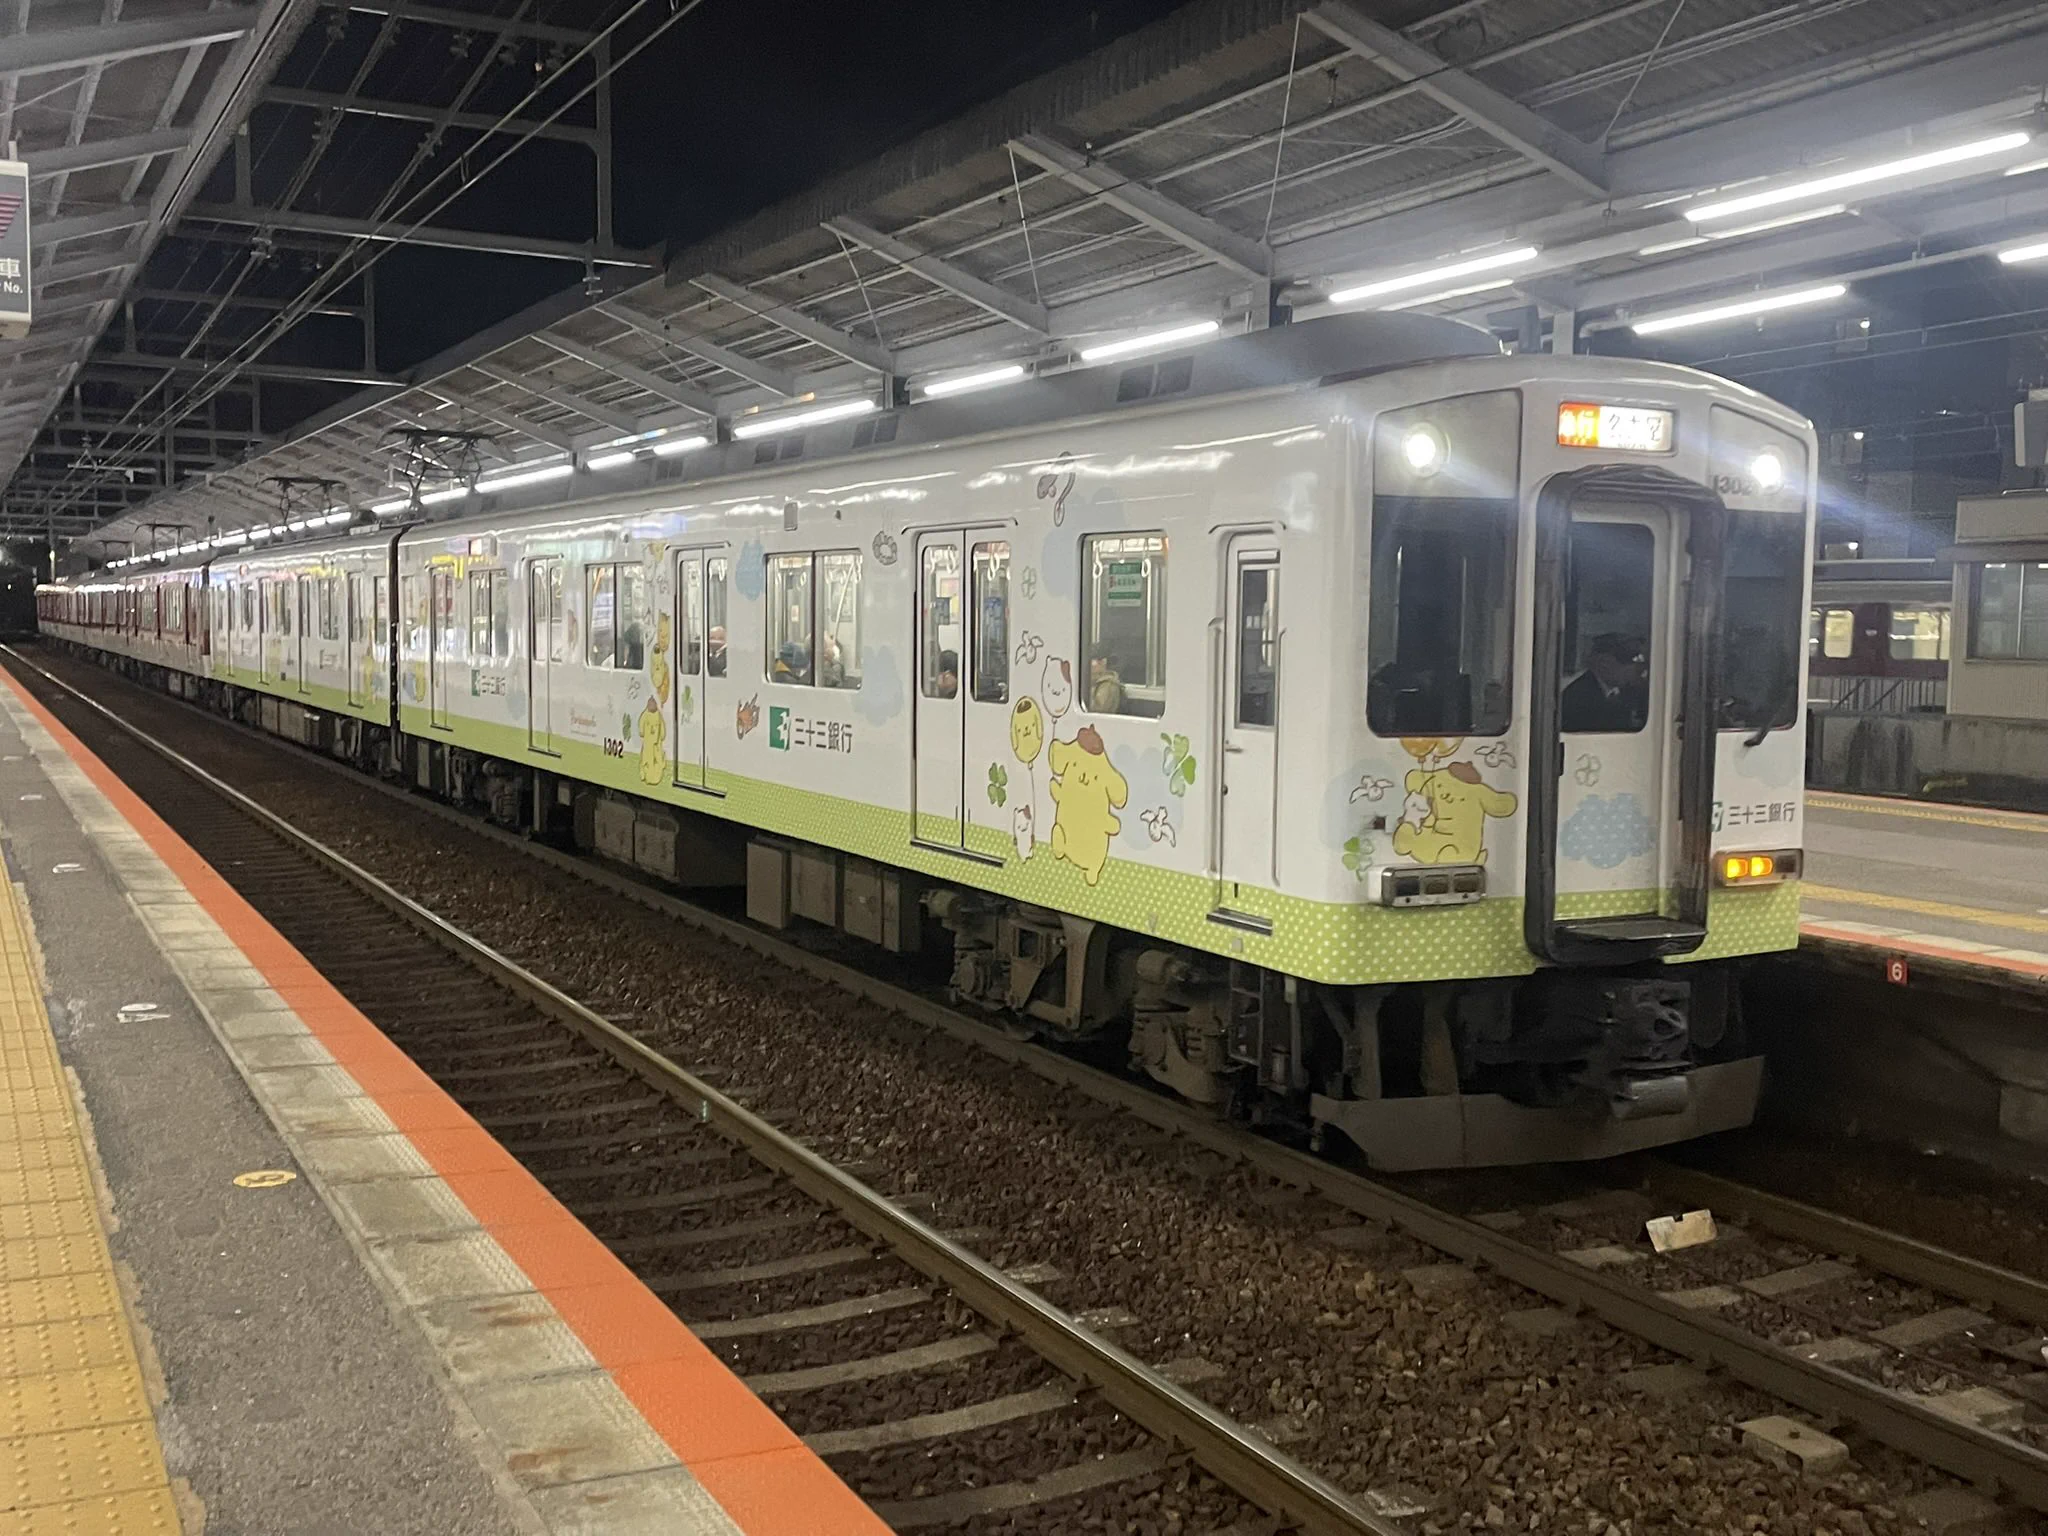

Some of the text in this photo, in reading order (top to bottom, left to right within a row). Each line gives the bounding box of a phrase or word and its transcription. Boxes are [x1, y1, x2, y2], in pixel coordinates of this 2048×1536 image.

[3, 281, 24, 294] No.
[603, 736, 624, 759] 1302
[794, 718, 853, 754] 三十三銀行
[1727, 801, 1796, 826] 三十三銀行
[1891, 962, 1903, 981] 6
